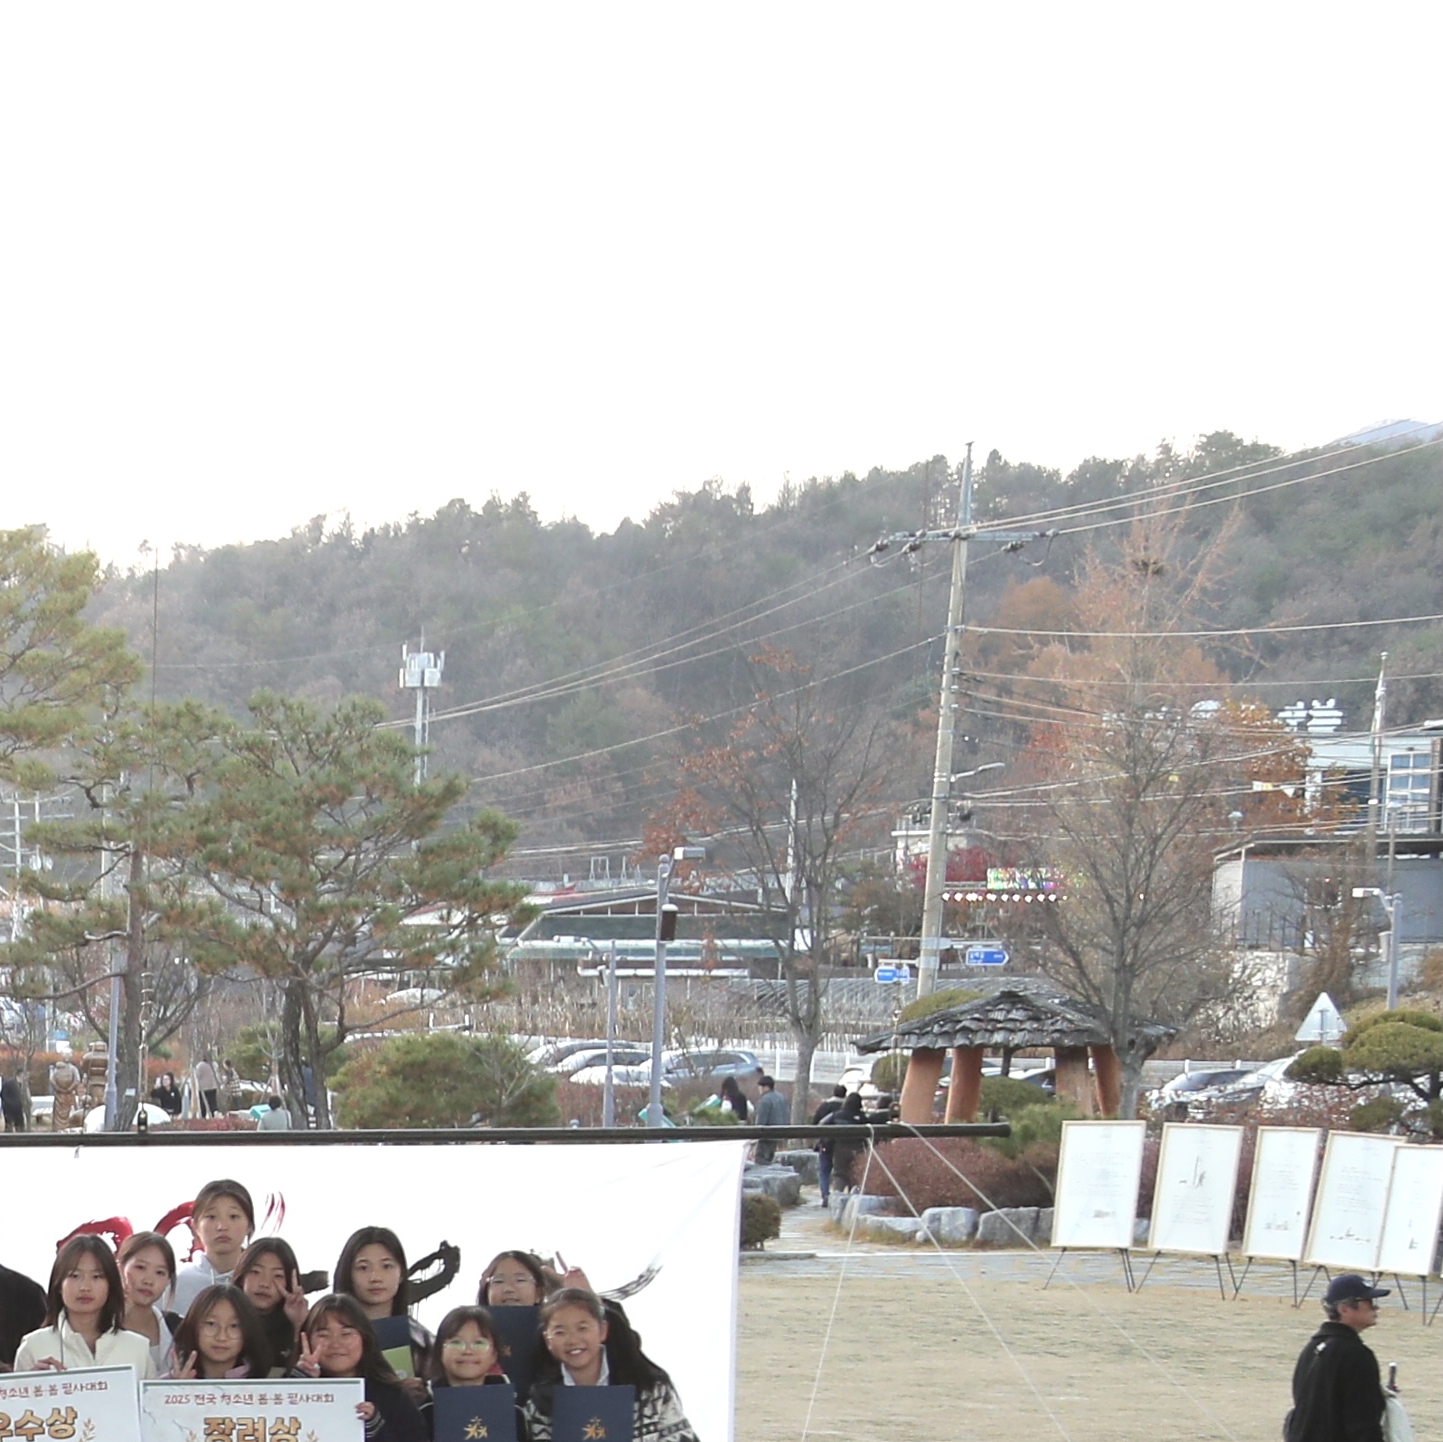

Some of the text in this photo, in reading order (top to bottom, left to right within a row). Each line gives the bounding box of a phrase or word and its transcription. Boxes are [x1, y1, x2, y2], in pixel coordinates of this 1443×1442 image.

[61, 1381, 108, 1396] 필사대회
[164, 1394, 190, 1404] 2025
[194, 1393, 217, 1405] 전국
[220, 1393, 254, 1406] 청소년
[287, 1393, 335, 1405] 필사대회
